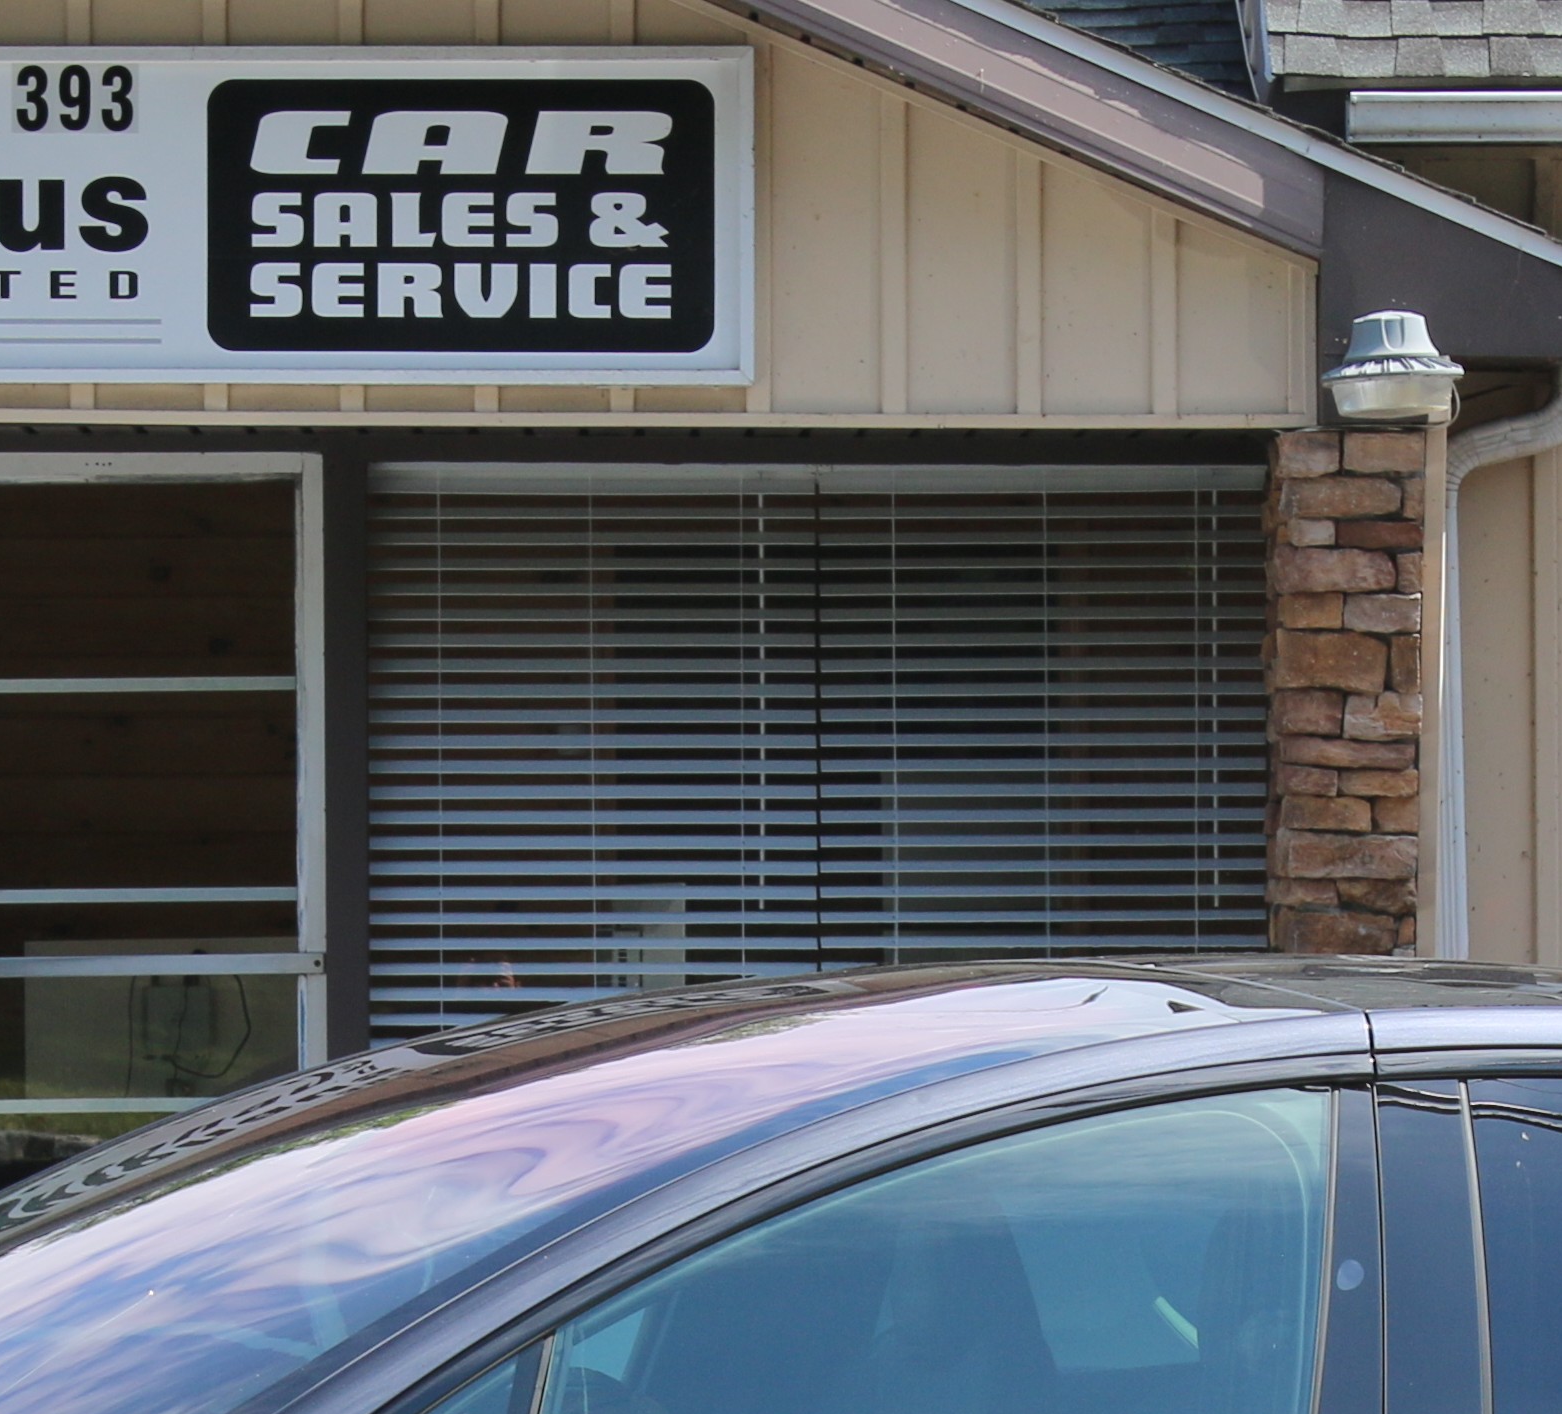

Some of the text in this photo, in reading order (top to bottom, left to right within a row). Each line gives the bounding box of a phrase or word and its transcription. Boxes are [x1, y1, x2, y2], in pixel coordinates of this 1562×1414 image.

[16, 65, 135, 132] 393
[250, 110, 673, 175] CAR
[251, 192, 669, 248] SALES &
[249, 262, 672, 319] SERVICE
